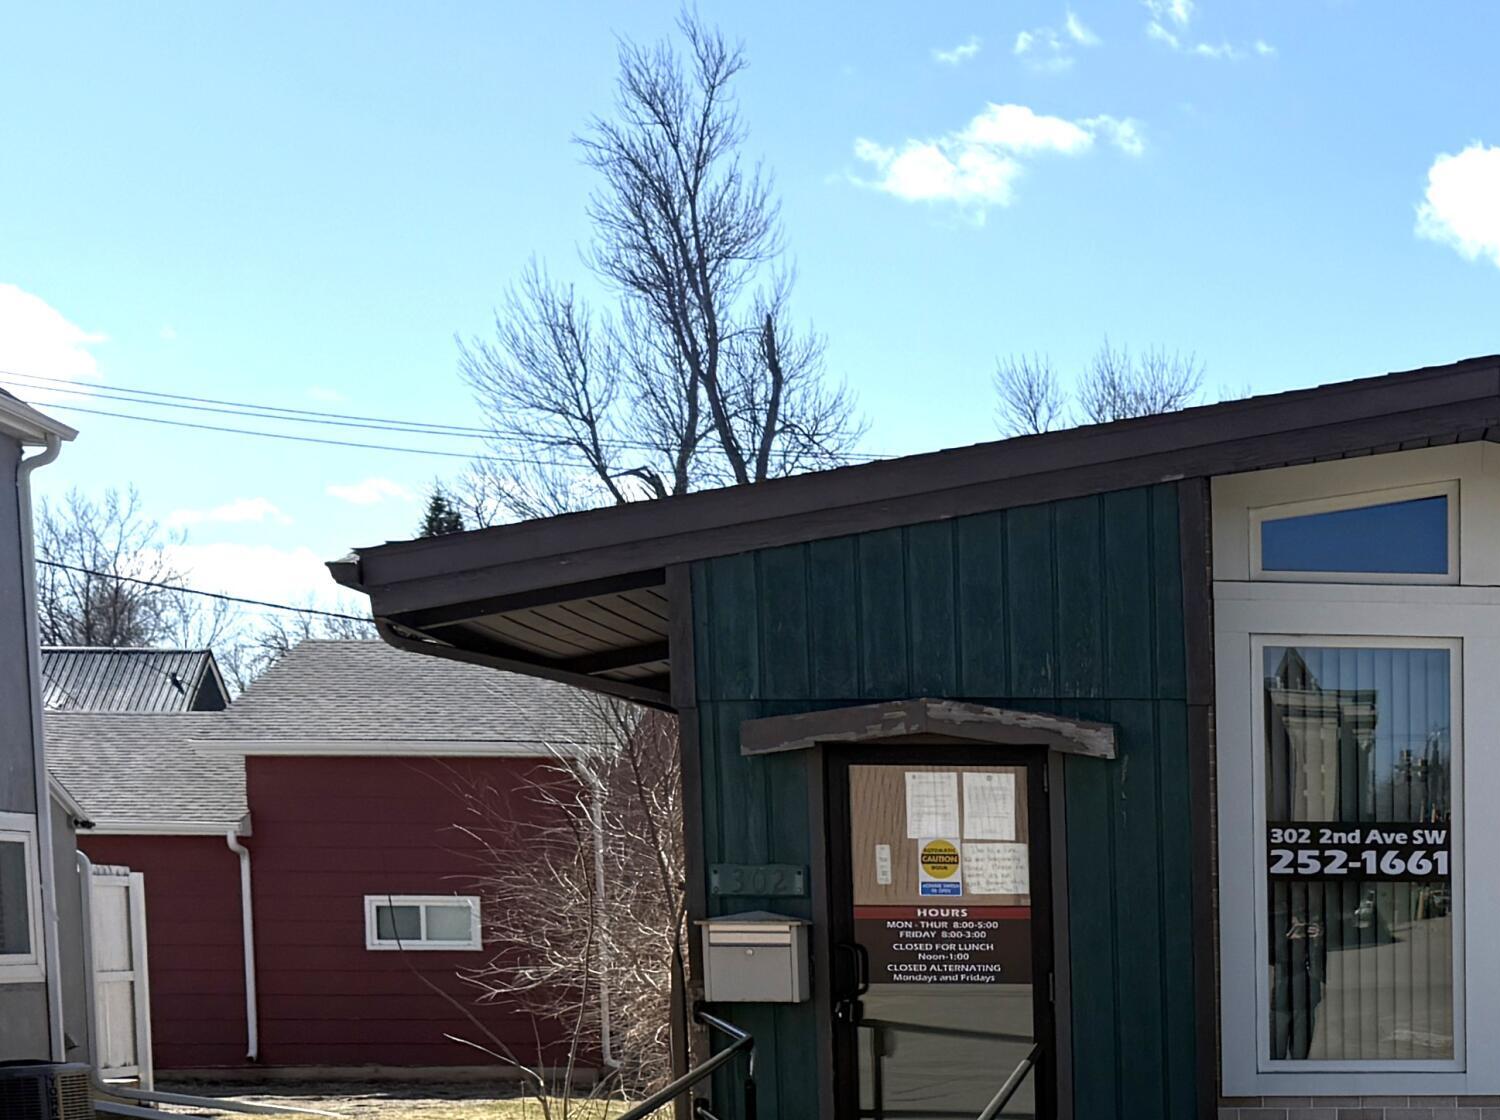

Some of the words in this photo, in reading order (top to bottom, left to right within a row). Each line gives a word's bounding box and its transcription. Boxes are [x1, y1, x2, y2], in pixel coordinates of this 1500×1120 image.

[1270, 828, 1311, 844] 302
[1319, 828, 1361, 844] 2nd
[1365, 829, 1408, 845] Ave
[1412, 829, 1447, 845] SW
[922, 855, 958, 863] CAUTION
[1269, 849, 1449, 875] 252-1661
[732, 868, 787, 893] 302
[917, 908, 968, 918] HOURS
[886, 921, 913, 929] MON
[920, 921, 949, 929] THUR
[952, 921, 999, 929] 8:00-5:00
[899, 930, 937, 939] FRIDAY
[941, 930, 987, 939] 8:00-3:00
[892, 943, 933, 951] CLOSED
[935, 943, 956, 951] FOR
[958, 943, 994, 951] LUNCH
[918, 952, 970, 960] Noon-1:00
[887, 964, 927, 972] CLOSED
[929, 964, 1001, 972] ALTERNATING
[893, 973, 937, 983] Mondays
[960, 973, 995, 983] Fridays
